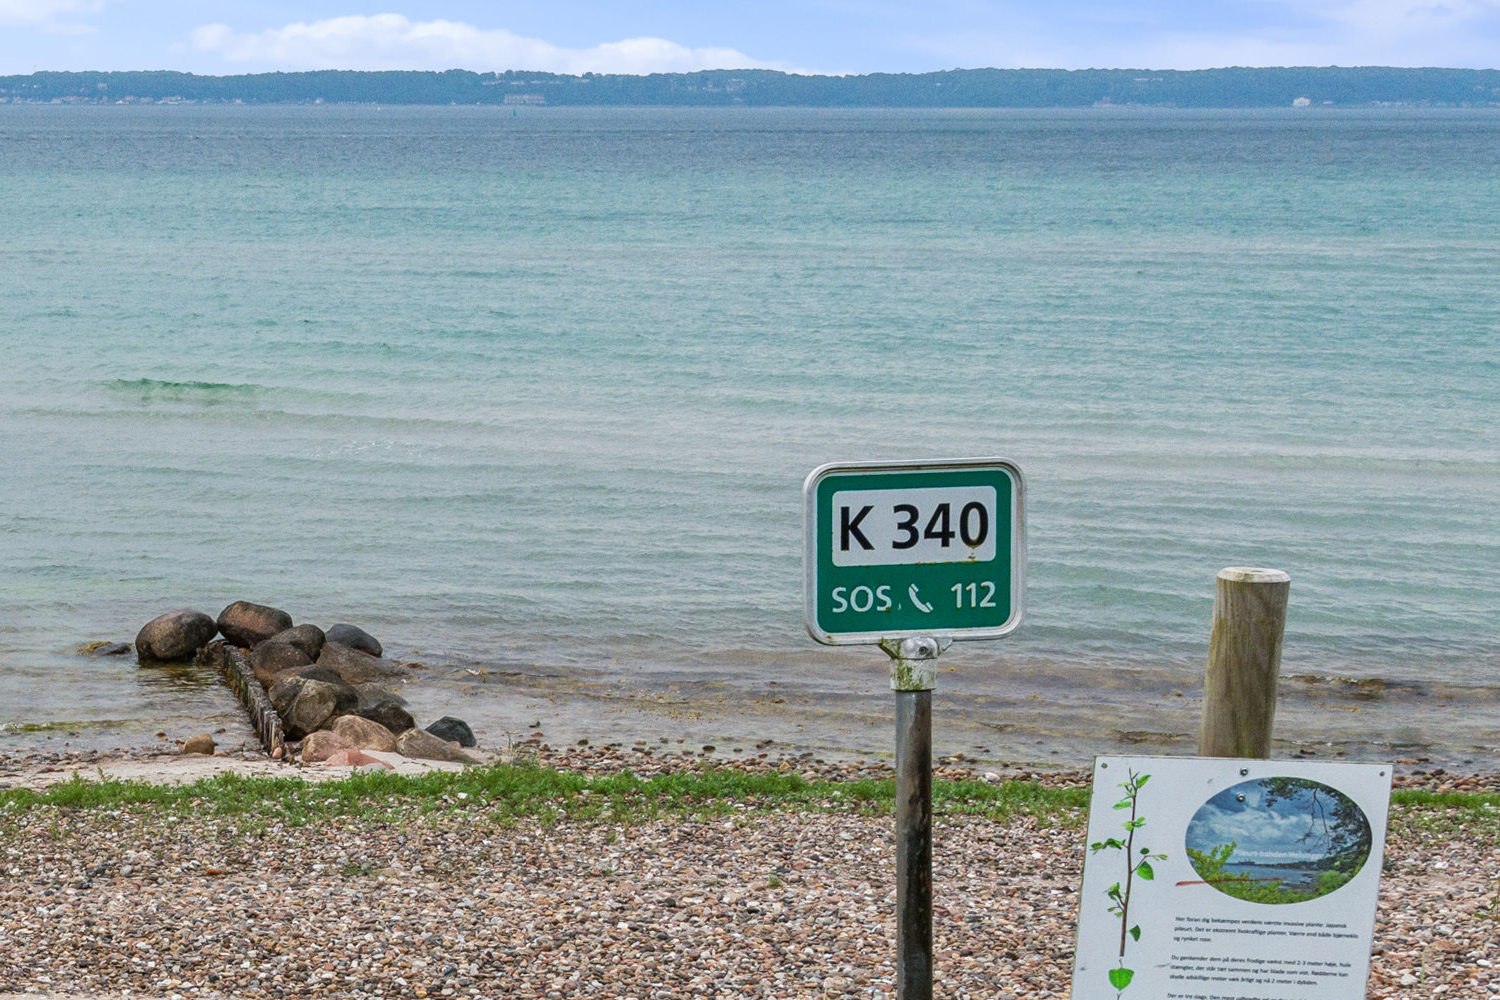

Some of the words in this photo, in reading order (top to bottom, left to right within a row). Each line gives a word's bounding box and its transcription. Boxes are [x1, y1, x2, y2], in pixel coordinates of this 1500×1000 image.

[840, 505, 875, 551] K
[892, 501, 989, 550] 340
[831, 585, 892, 613] SOS
[951, 581, 996, 608] 112
